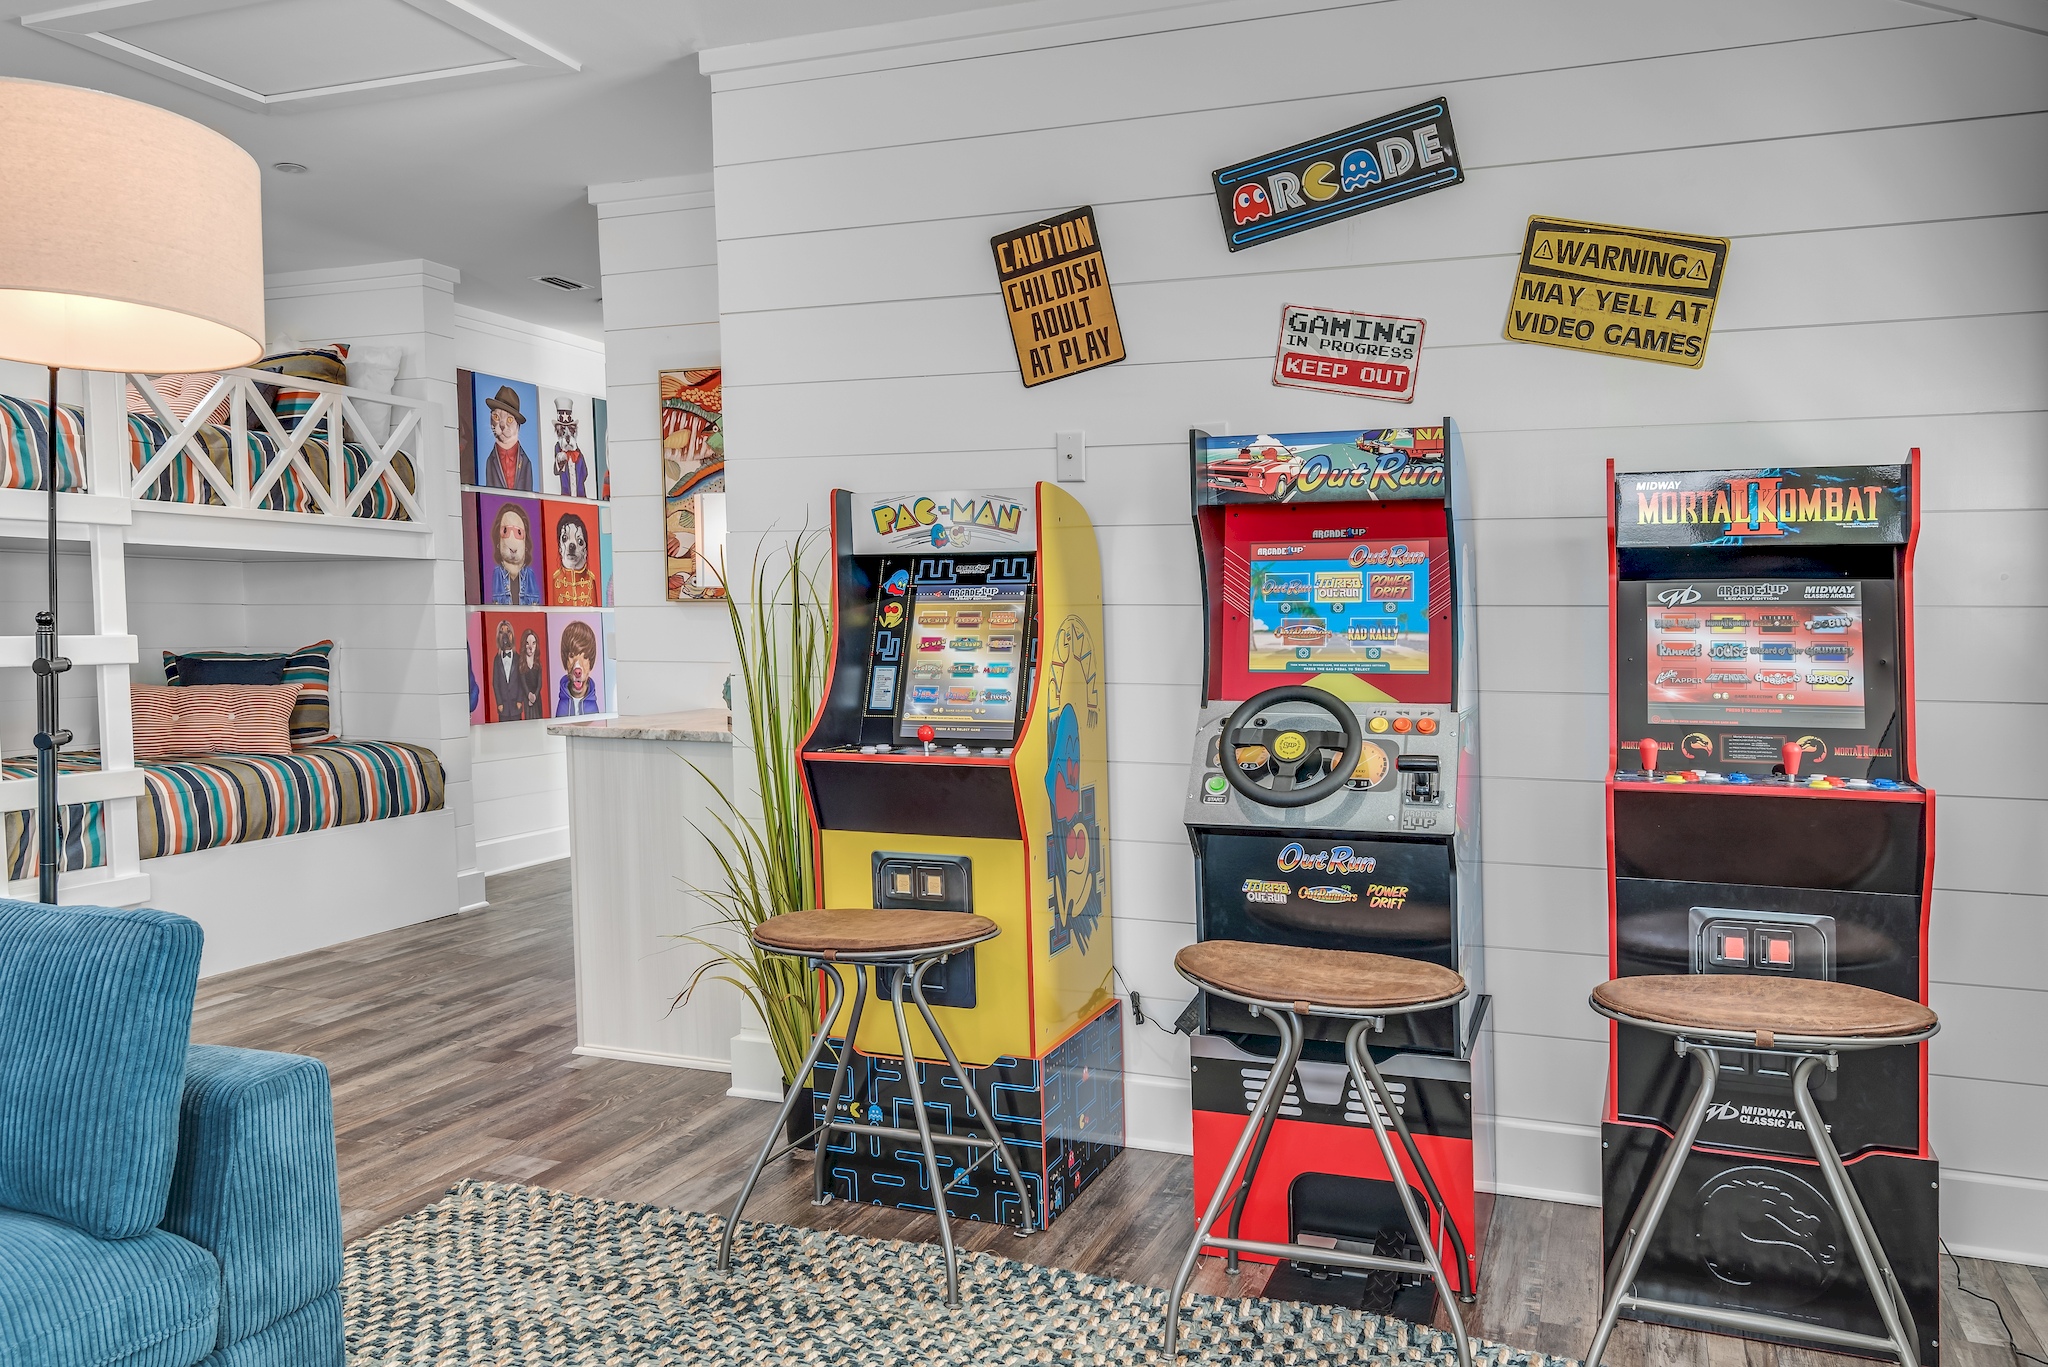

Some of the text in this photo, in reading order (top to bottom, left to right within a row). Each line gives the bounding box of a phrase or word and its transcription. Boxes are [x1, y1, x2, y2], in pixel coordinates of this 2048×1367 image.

[1233, 123, 1446, 226] ARCADE
[997, 215, 1095, 274] CAUTION
[1556, 238, 1688, 280] WARNING
[1007, 257, 1102, 313] CHILDISH
[1520, 279, 1708, 325] MAY YELL AT
[1031, 296, 1093, 342] ADULT
[1288, 312, 1417, 345] GAMING
[1286, 334, 1414, 360] IN PROGRESS
[1514, 310, 1702, 358] VIDEO GAMES
[1029, 326, 1111, 378] AT PLAY
[1285, 357, 1406, 386] KEEP OUT
[1635, 481, 1682, 491] MIDWAY
[871, 496, 1022, 536] PAC-MAN
[1636, 489, 1752, 526] MORTAL
[1755, 485, 1883, 524] KOMBAT
[1371, 575, 1411, 587] POWER
[1373, 586, 1408, 598] DRIFT
[1347, 624, 1399, 640] RAD RALLY
[1657, 644, 1702, 657] RAMPAGE
[1403, 816, 1437, 831] 1UP
[1366, 884, 1409, 898] POWER
[1369, 896, 1406, 910] DRIFT
[1739, 1115, 1832, 1134] CLASSIC ARE
[1740, 1105, 1796, 1120] MIDWAY
